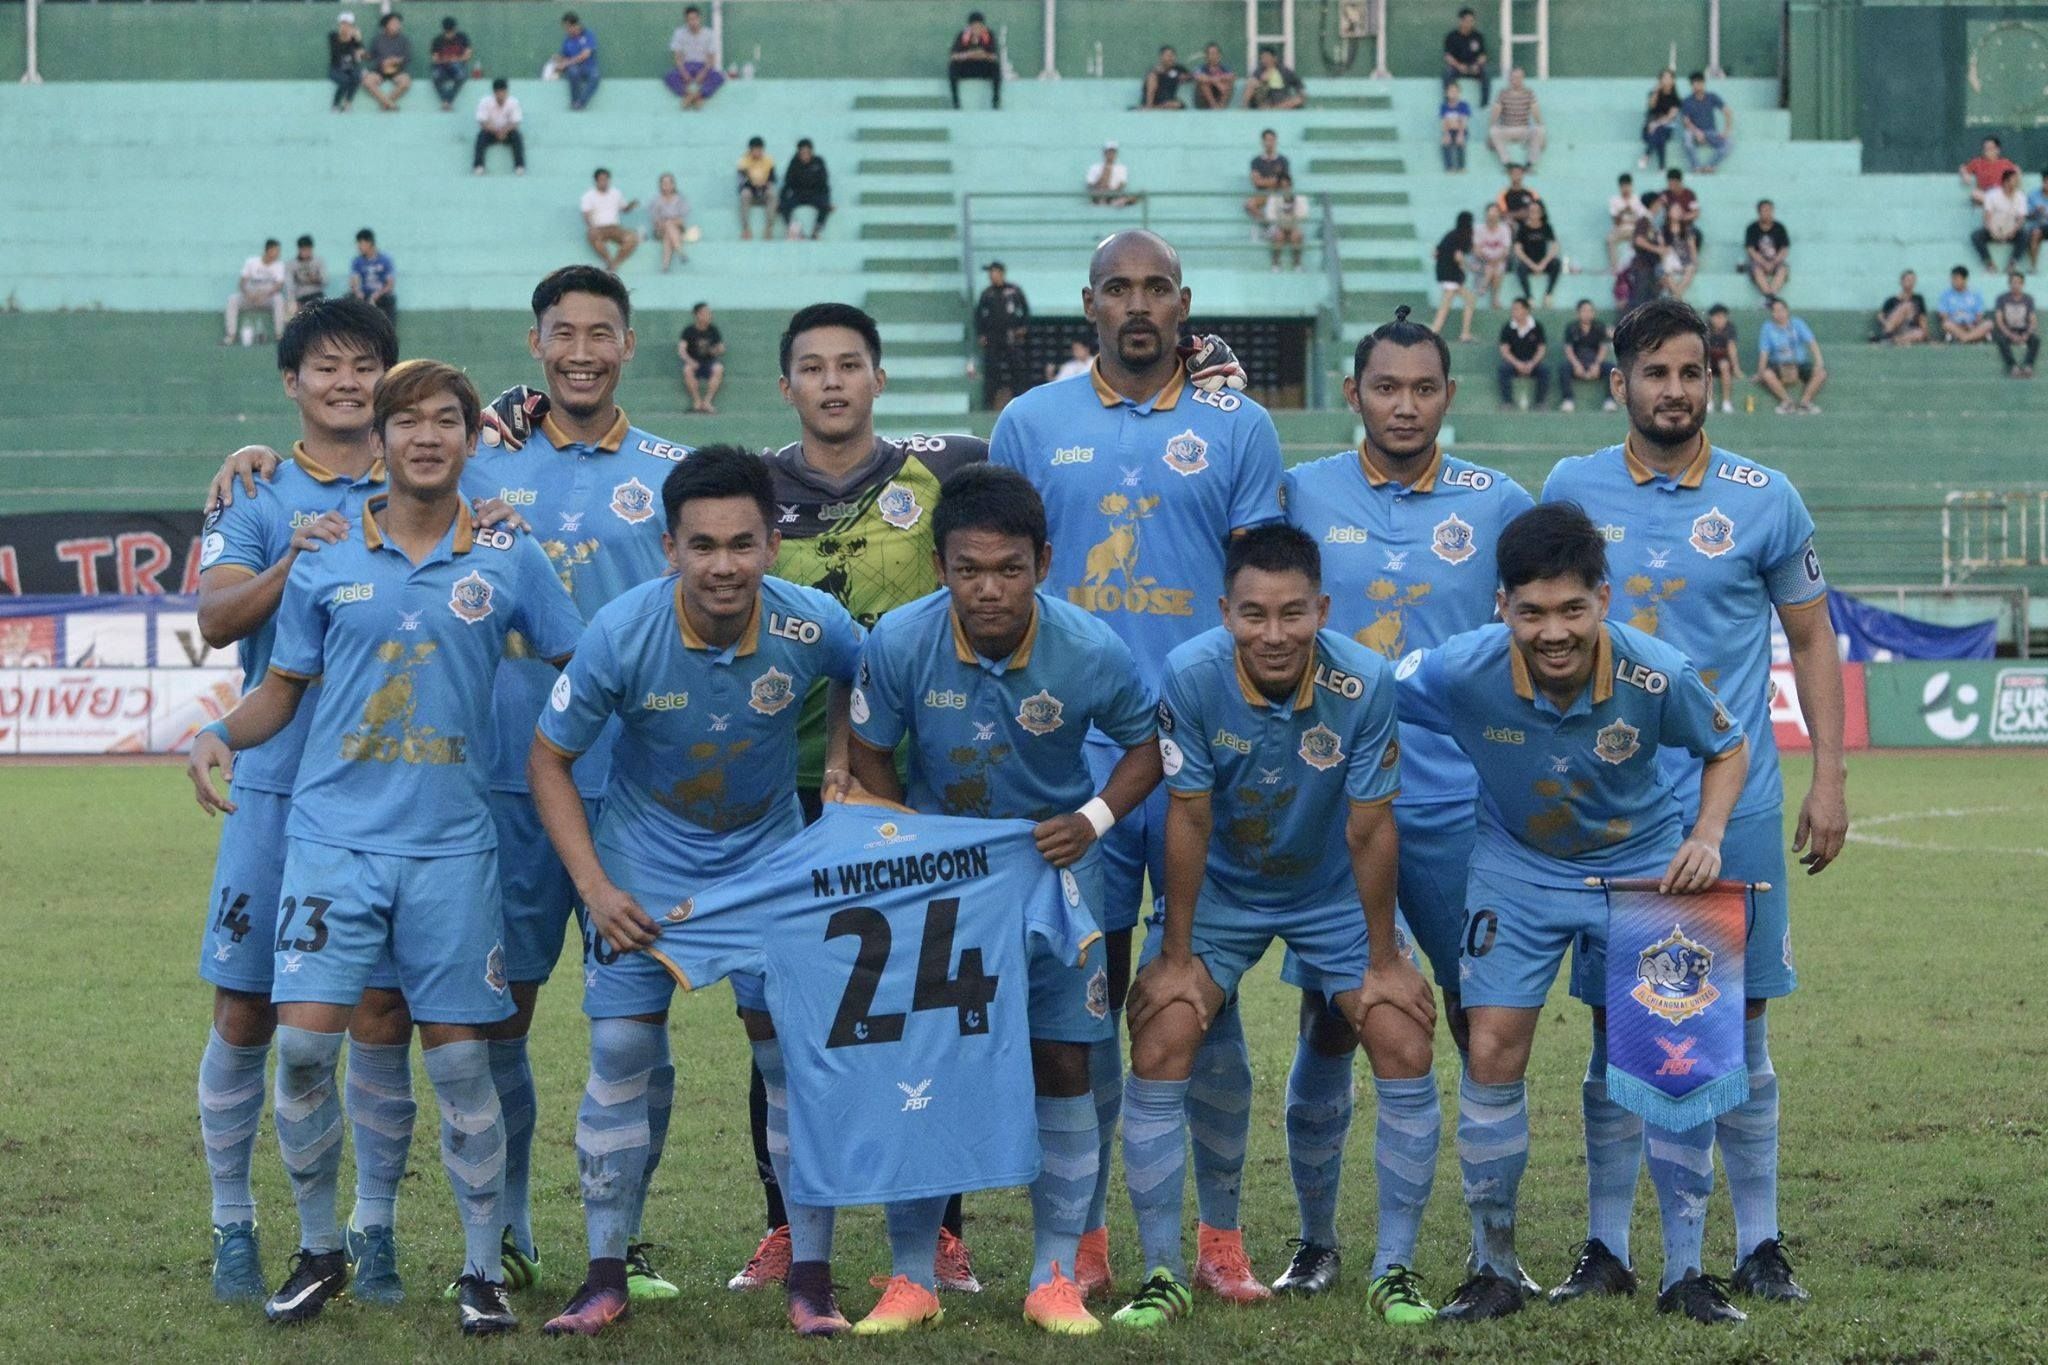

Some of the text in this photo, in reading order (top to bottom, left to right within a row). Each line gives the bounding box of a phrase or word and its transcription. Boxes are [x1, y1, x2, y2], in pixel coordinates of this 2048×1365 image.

[1192, 388, 1241, 412] LEO
[638, 440, 688, 462] LEO
[1051, 445, 1094, 465] Jele
[1441, 465, 1493, 491] LEO
[1717, 462, 1770, 488] LEO
[818, 502, 859, 520] Jele
[473, 528, 515, 551] EO
[1325, 525, 1368, 543] Jele
[331, 582, 374, 605] Jele
[768, 612, 822, 644] LEO
[1314, 663, 1364, 700] LEO
[1616, 658, 1669, 694] LEO
[643, 691, 688, 711] Jele
[924, 689, 967, 709] Jele
[1213, 728, 1251, 754] Jele
[1482, 726, 1526, 745] Jele
[811, 845, 989, 897] N. WICHAGORN
[212, 886, 252, 944] 14
[274, 895, 334, 953] 23
[823, 897, 999, 1049] 24
[1646, 994, 1689, 1009] CHIANGMAI
[901, 1096, 932, 1112] FBT
